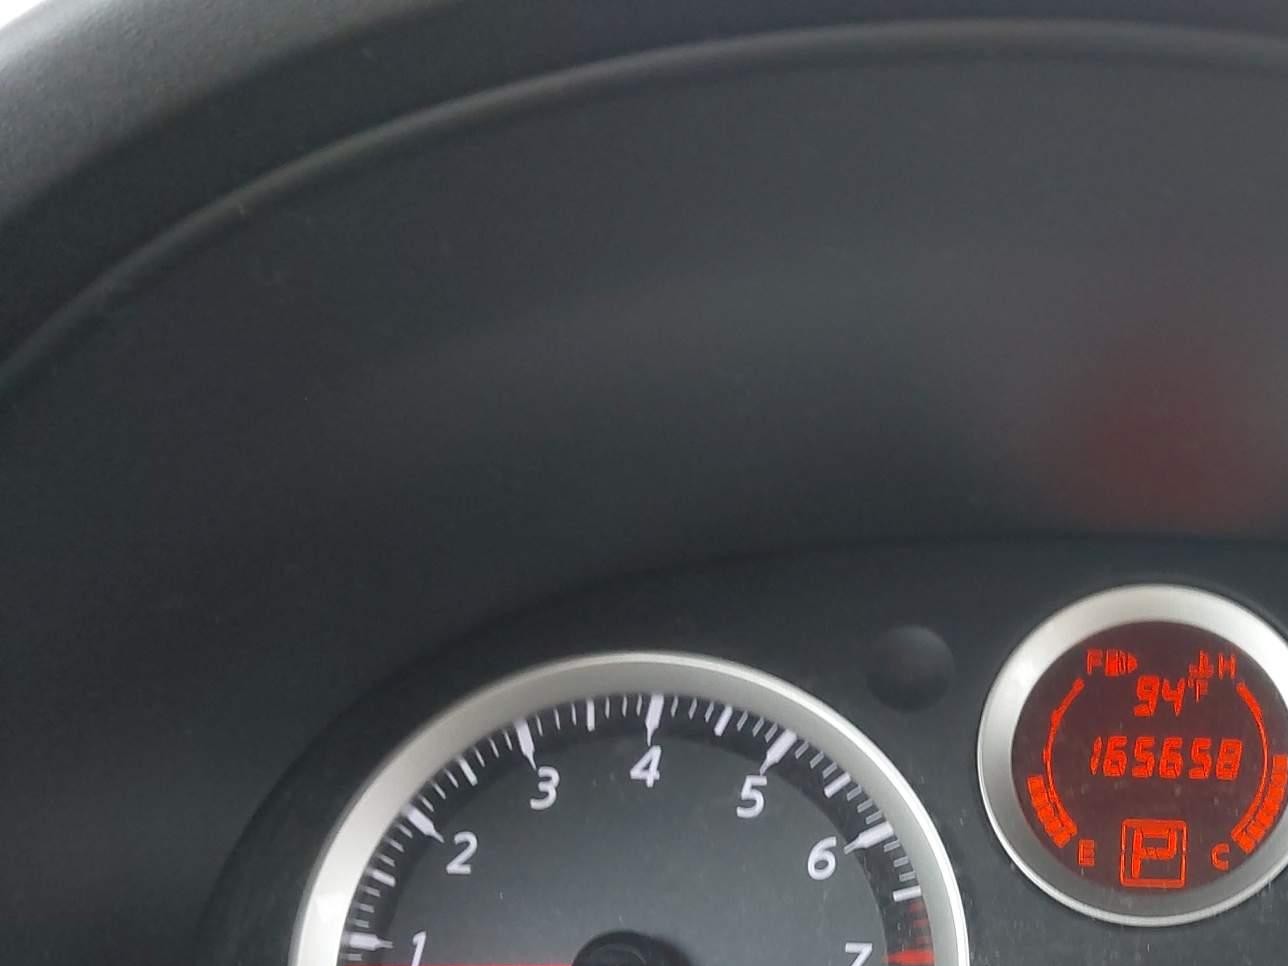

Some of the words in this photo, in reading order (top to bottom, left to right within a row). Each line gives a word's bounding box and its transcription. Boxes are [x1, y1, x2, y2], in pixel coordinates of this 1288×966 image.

[1087, 649, 1103, 676] F
[1218, 653, 1237, 680] H
[629, 746, 662, 787] 4
[1090, 736, 1243, 781] 165658
[529, 767, 560, 810] 3
[736, 775, 767, 819] 5
[445, 831, 478, 875] 2
[807, 836, 838, 881] 6
[1077, 838, 1096, 868] E
[1131, 829, 1178, 879] P
[1210, 842, 1230, 871] C
